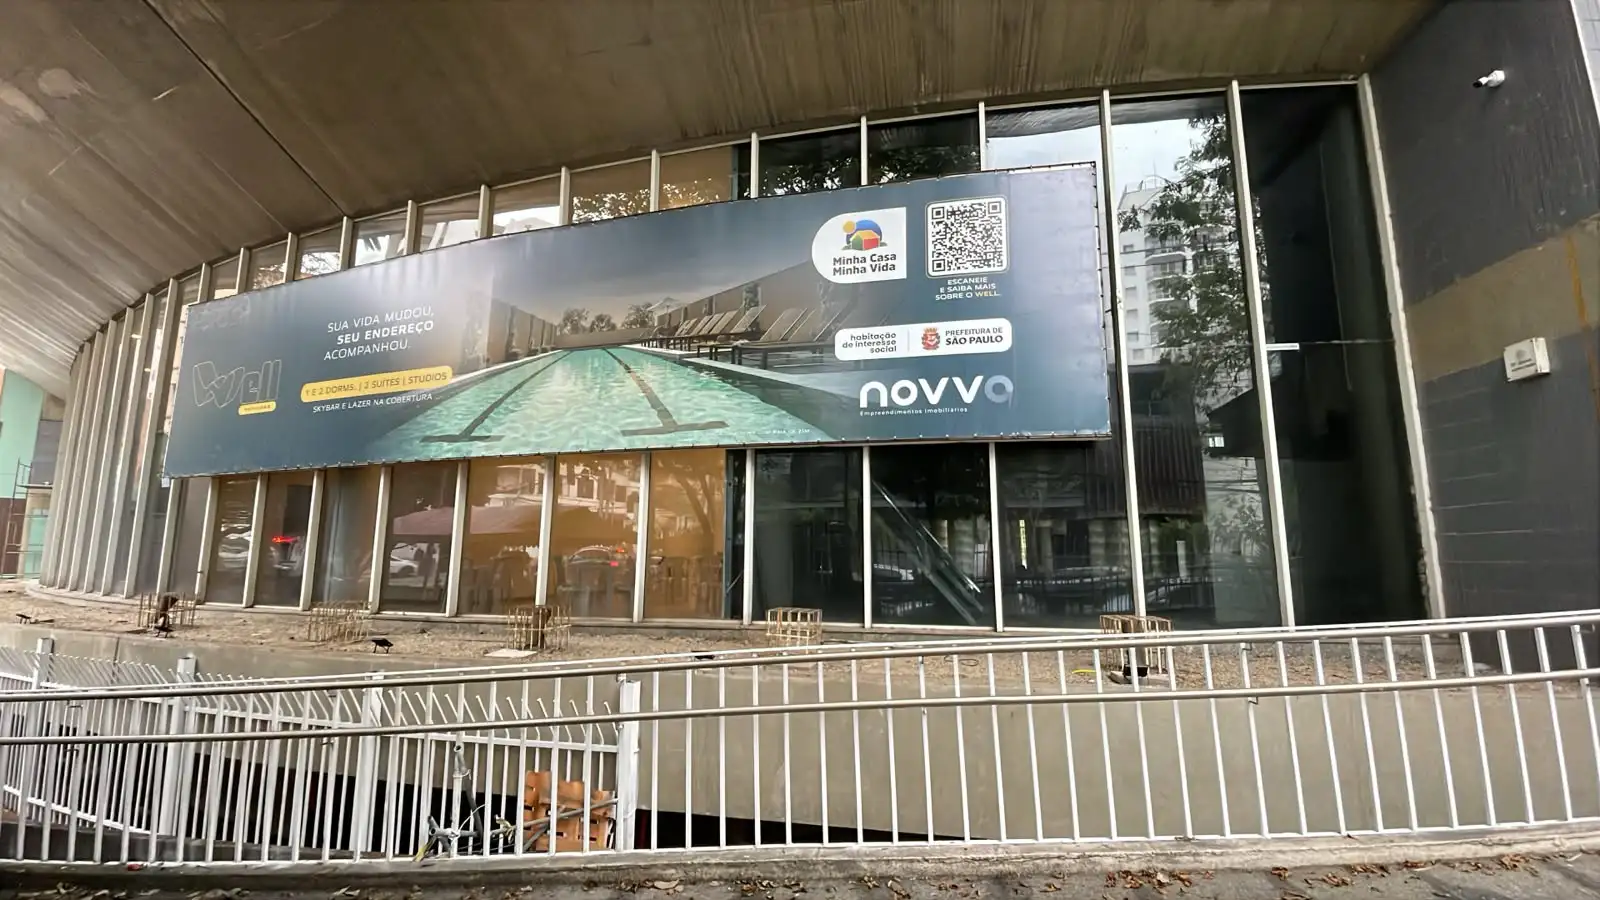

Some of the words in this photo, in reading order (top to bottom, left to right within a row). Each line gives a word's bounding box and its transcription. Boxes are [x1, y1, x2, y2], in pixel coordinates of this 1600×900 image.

[832, 256, 867, 267] Minha
[869, 252, 897, 263] Casa
[832, 266, 867, 276] Minha
[871, 263, 896, 273] Vida
[947, 276, 988, 286] ESCANEIE
[947, 285, 973, 293] SAIBA
[974, 283, 996, 291] MAIS
[935, 293, 963, 301] SOBRE
[327, 321, 349, 333] SUA
[352, 315, 380, 329] VIDA
[336, 332, 360, 345] SEU
[364, 320, 435, 341] ENDEREÇO
[850, 332, 897, 341] habitação
[945, 329, 990, 337] PREFEITURA
[855, 339, 897, 348] interesse
[945, 335, 967, 346] SÃO
[969, 335, 1003, 344] PAULO
[870, 345, 897, 354] social
[407, 372, 447, 384] STUDIOS
[312, 404, 340, 413] SKYBAR
[347, 399, 371, 409] LAZER
[373, 398, 384, 406] NA
[386, 393, 433, 405] COBERTURA
